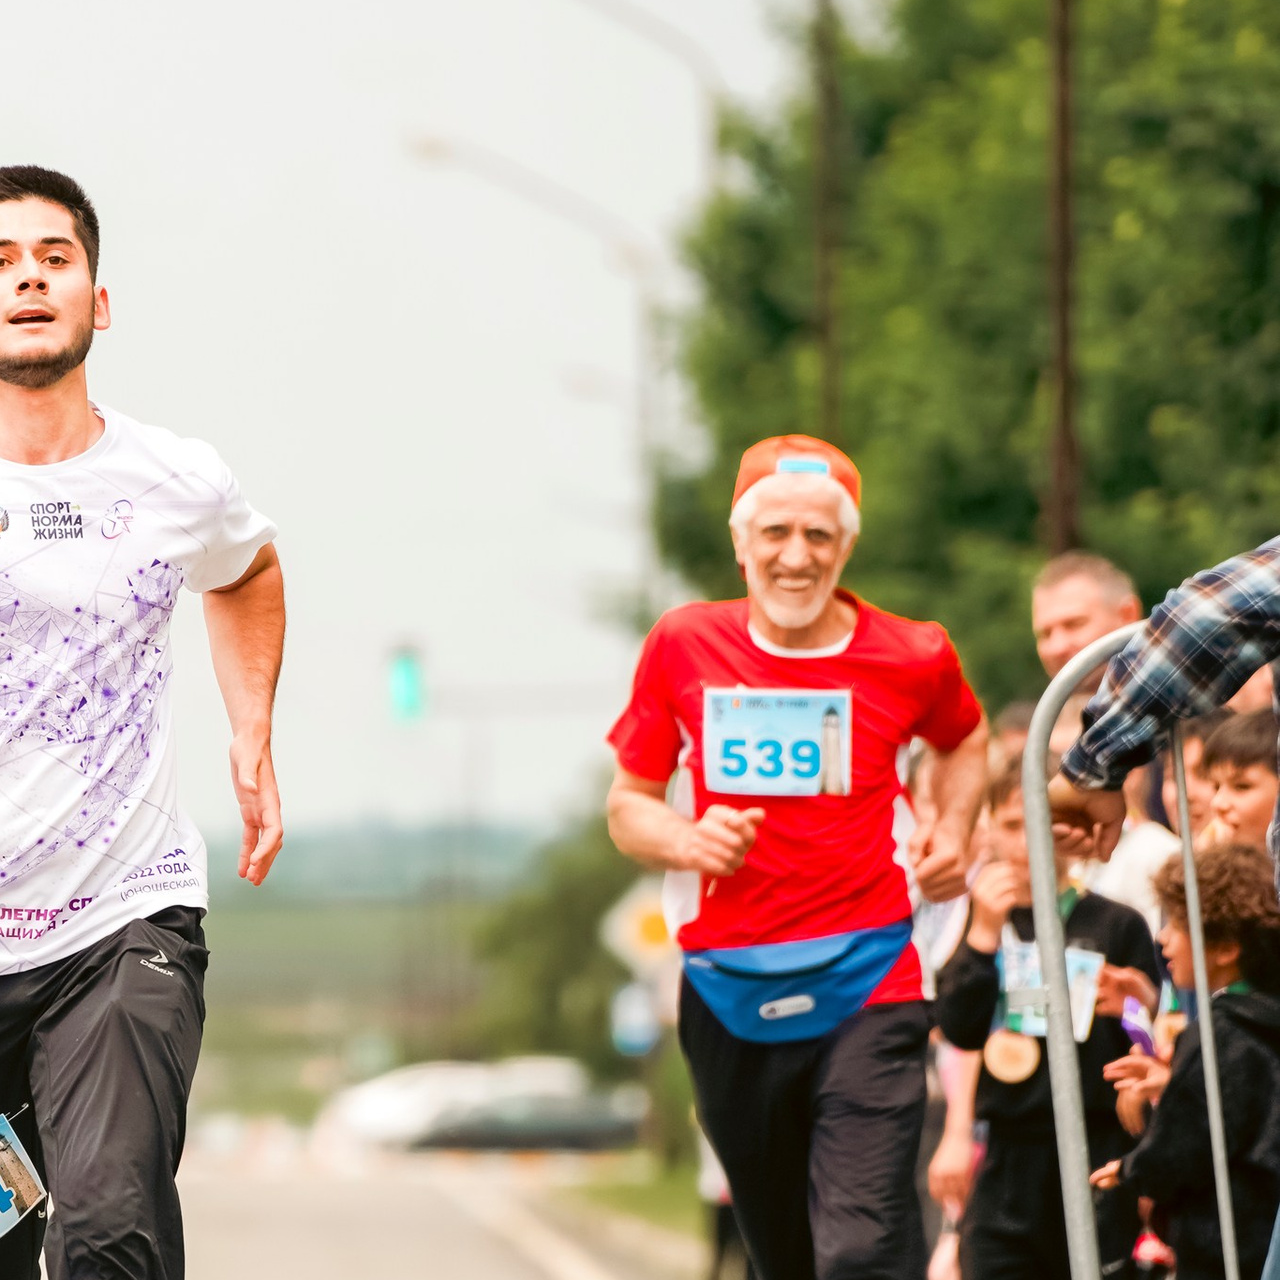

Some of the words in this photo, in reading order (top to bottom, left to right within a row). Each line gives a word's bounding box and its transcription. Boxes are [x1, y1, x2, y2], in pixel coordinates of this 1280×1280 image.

[30, 502, 71, 514] СПОРТ
[31, 514, 82, 527] НОРМА
[33, 527, 84, 540] ЖИЗНИ
[721, 739, 821, 779] 539
[156, 862, 192, 875] ГОДА
[0, 908, 63, 921] ЛЕТНЯ
[140, 959, 175, 977] DEMIX
